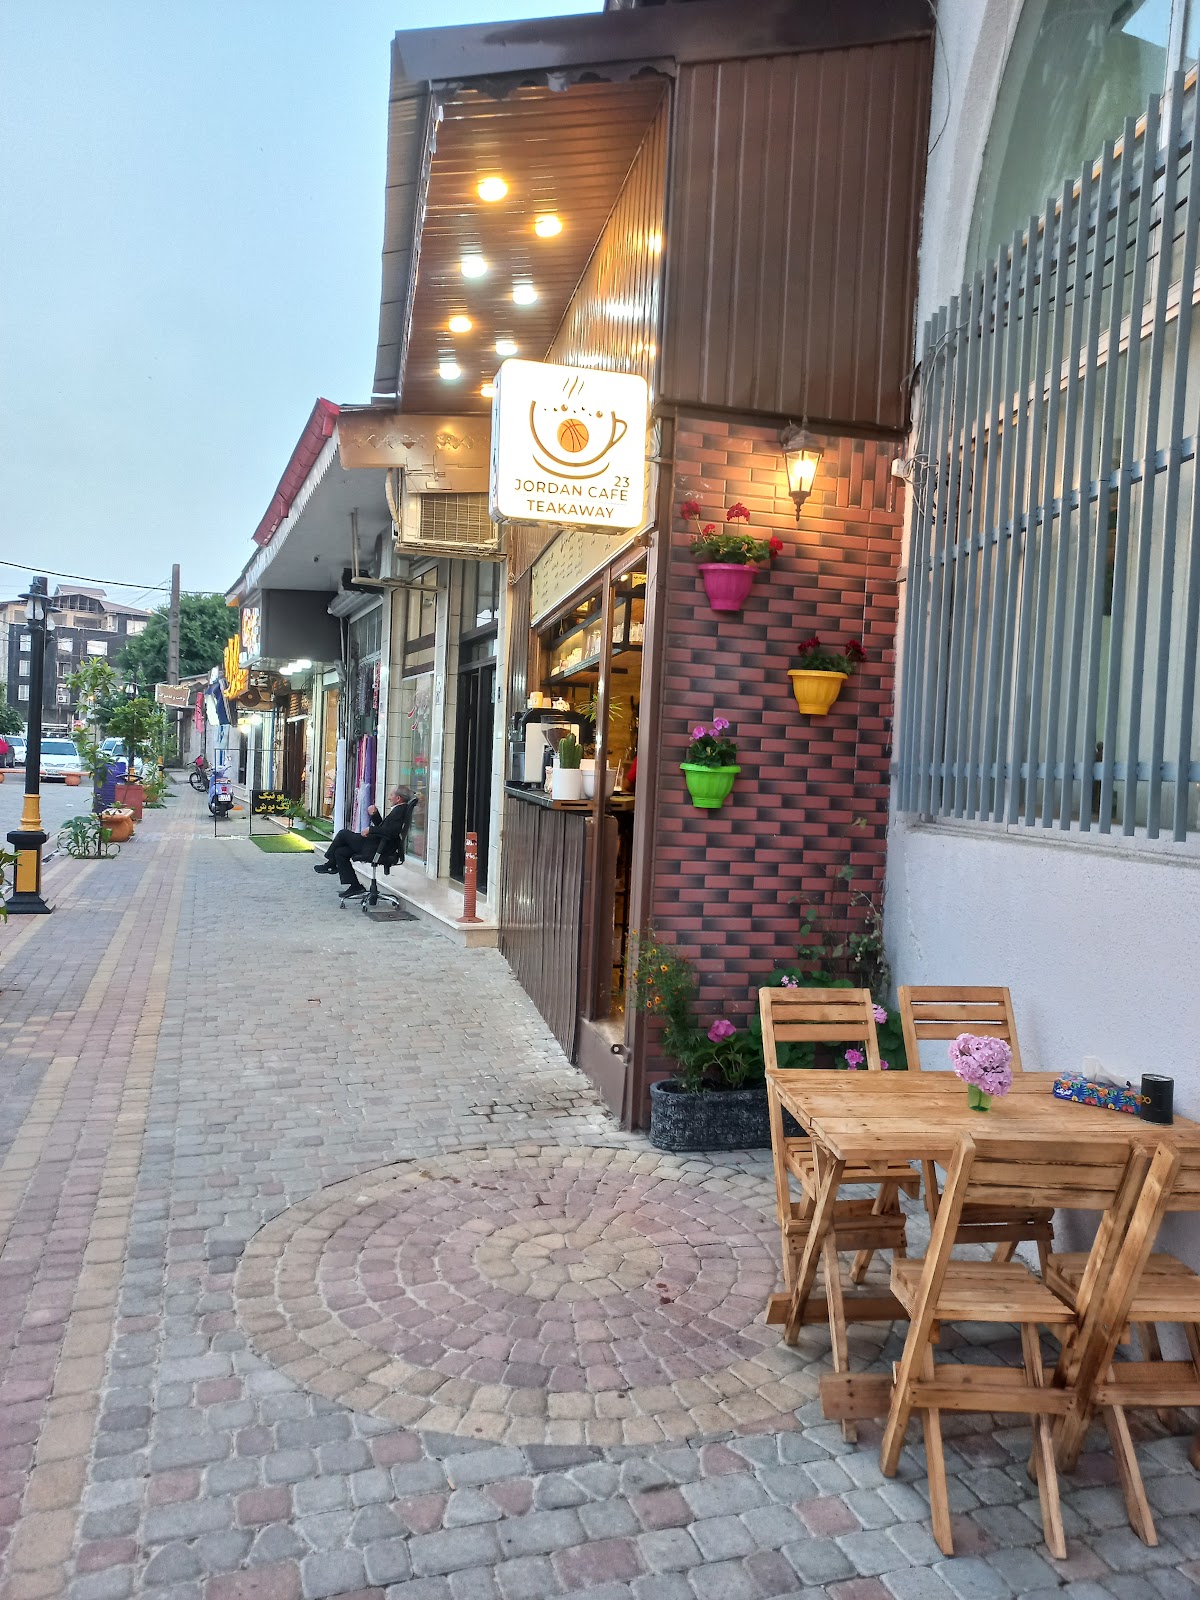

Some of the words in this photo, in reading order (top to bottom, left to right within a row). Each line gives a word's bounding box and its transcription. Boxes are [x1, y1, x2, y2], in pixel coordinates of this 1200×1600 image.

[515, 479, 583, 497] JORDAN
[588, 486, 628, 502] CAFE
[614, 476, 630, 488] 23
[527, 499, 614, 519] TEAKAWAY
